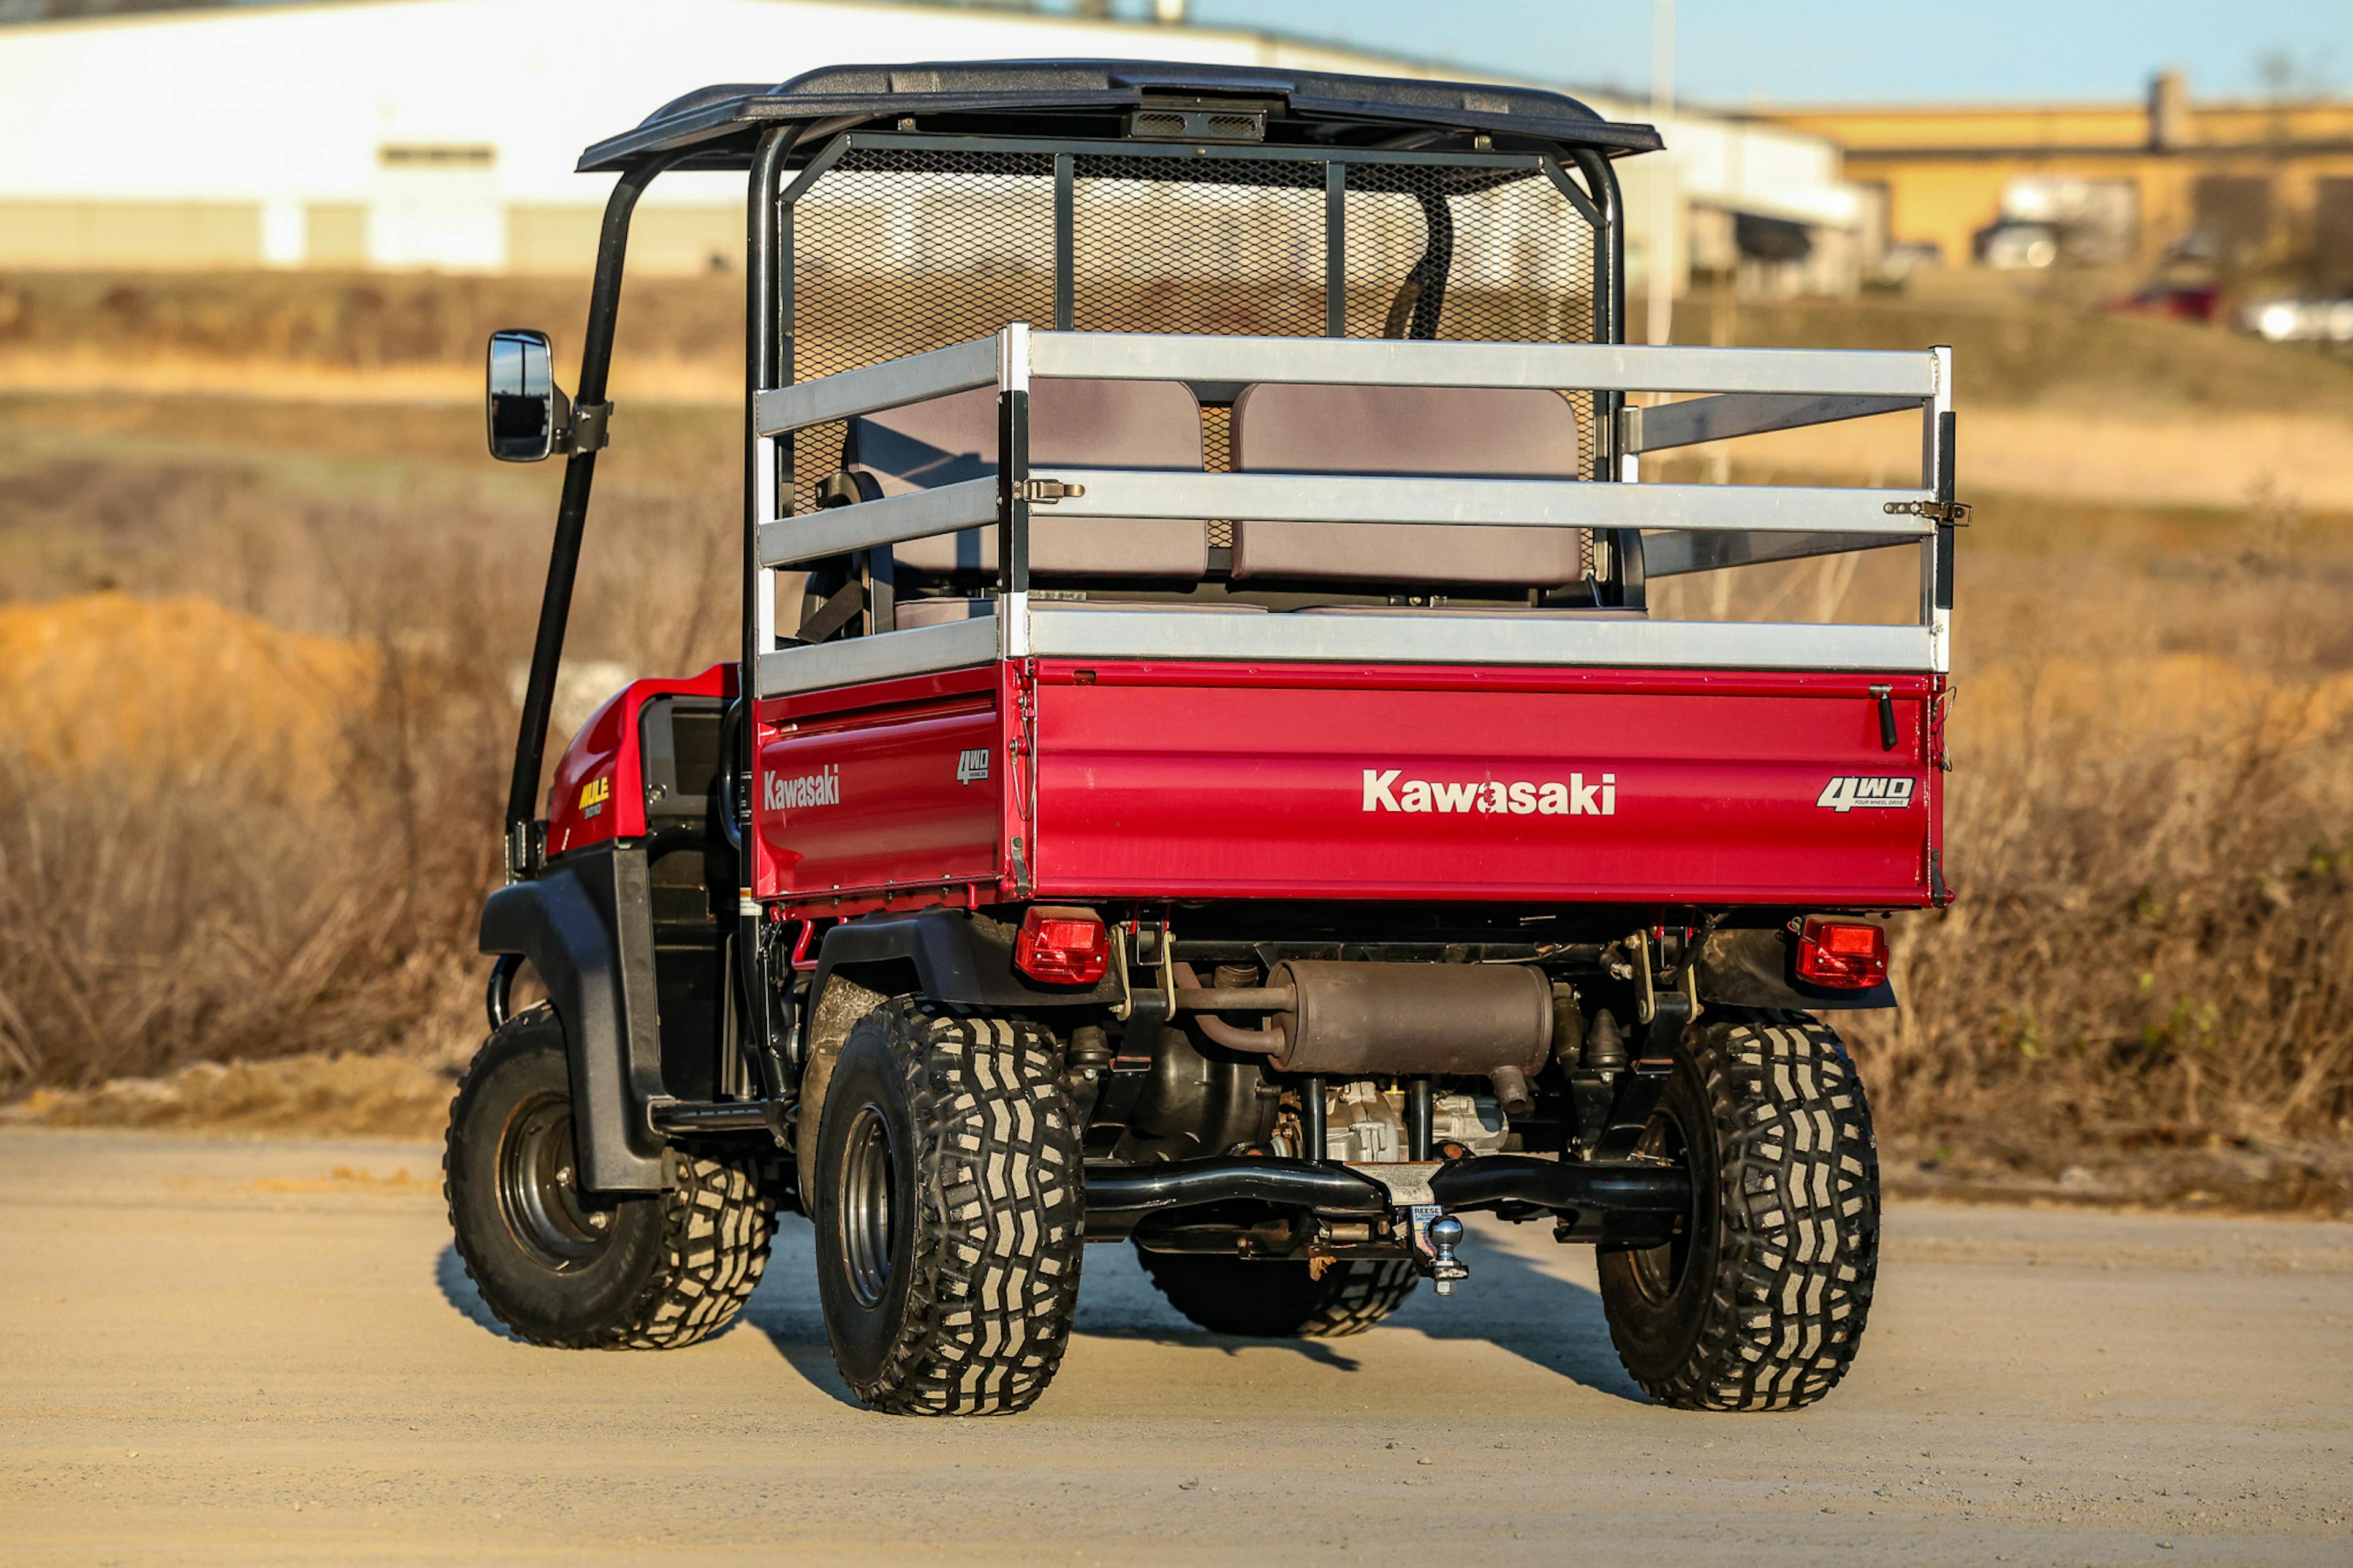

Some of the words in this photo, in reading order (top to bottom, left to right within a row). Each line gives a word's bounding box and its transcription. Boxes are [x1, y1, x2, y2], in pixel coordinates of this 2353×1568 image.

[957, 749, 989, 786] 4WD
[578, 776, 609, 810] MULE
[764, 763, 839, 811] Kawasaki
[1362, 769, 1616, 816] Kawasaki
[1816, 778, 1914, 812] 4WD
